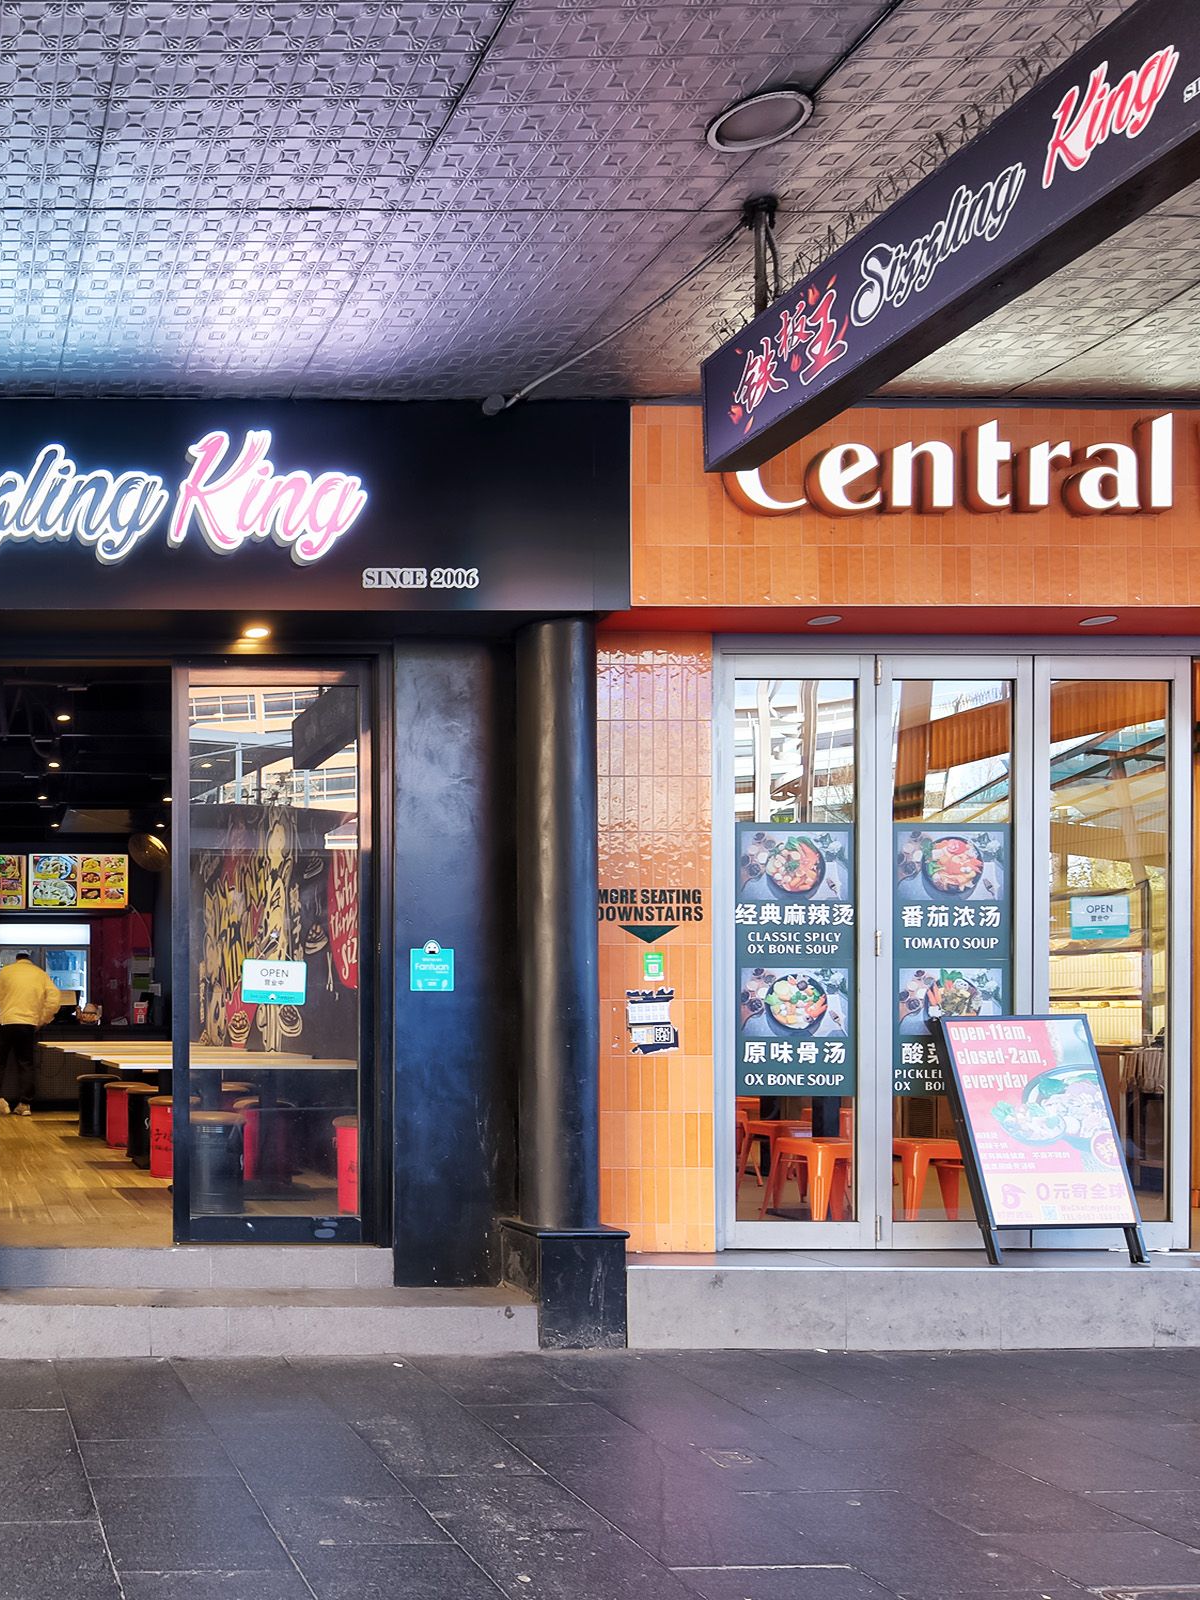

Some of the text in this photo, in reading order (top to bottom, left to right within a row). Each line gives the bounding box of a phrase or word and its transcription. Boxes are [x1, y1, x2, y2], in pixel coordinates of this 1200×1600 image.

[1043, 44, 1179, 189] King
[851, 162, 1026, 327] Sizzling
[735, 288, 847, 414] 铁板王
[167, 429, 369, 565] King
[362, 568, 480, 589] SINCE 2006
[598, 889, 702, 905] MORE SEATING
[735, 903, 854, 926] 经典麻辣烫
[901, 905, 1001, 928] 番茄浓汤
[1086, 904, 1114, 914] OPEN
[747, 932, 842, 942] CLASSIC SPICY
[903, 937, 999, 949] TOMATO SOUP
[747, 944, 839, 954] OX BONE SOUP
[260, 968, 289, 978] OPEN
[950, 1023, 1032, 1043] open-11am,
[743, 1041, 846, 1064] 原味骨汤
[956, 1047, 1048, 1066] closed-2am,
[744, 1073, 845, 1086] OX BONE SOUP
[894, 1081, 945, 1091] OX BO
